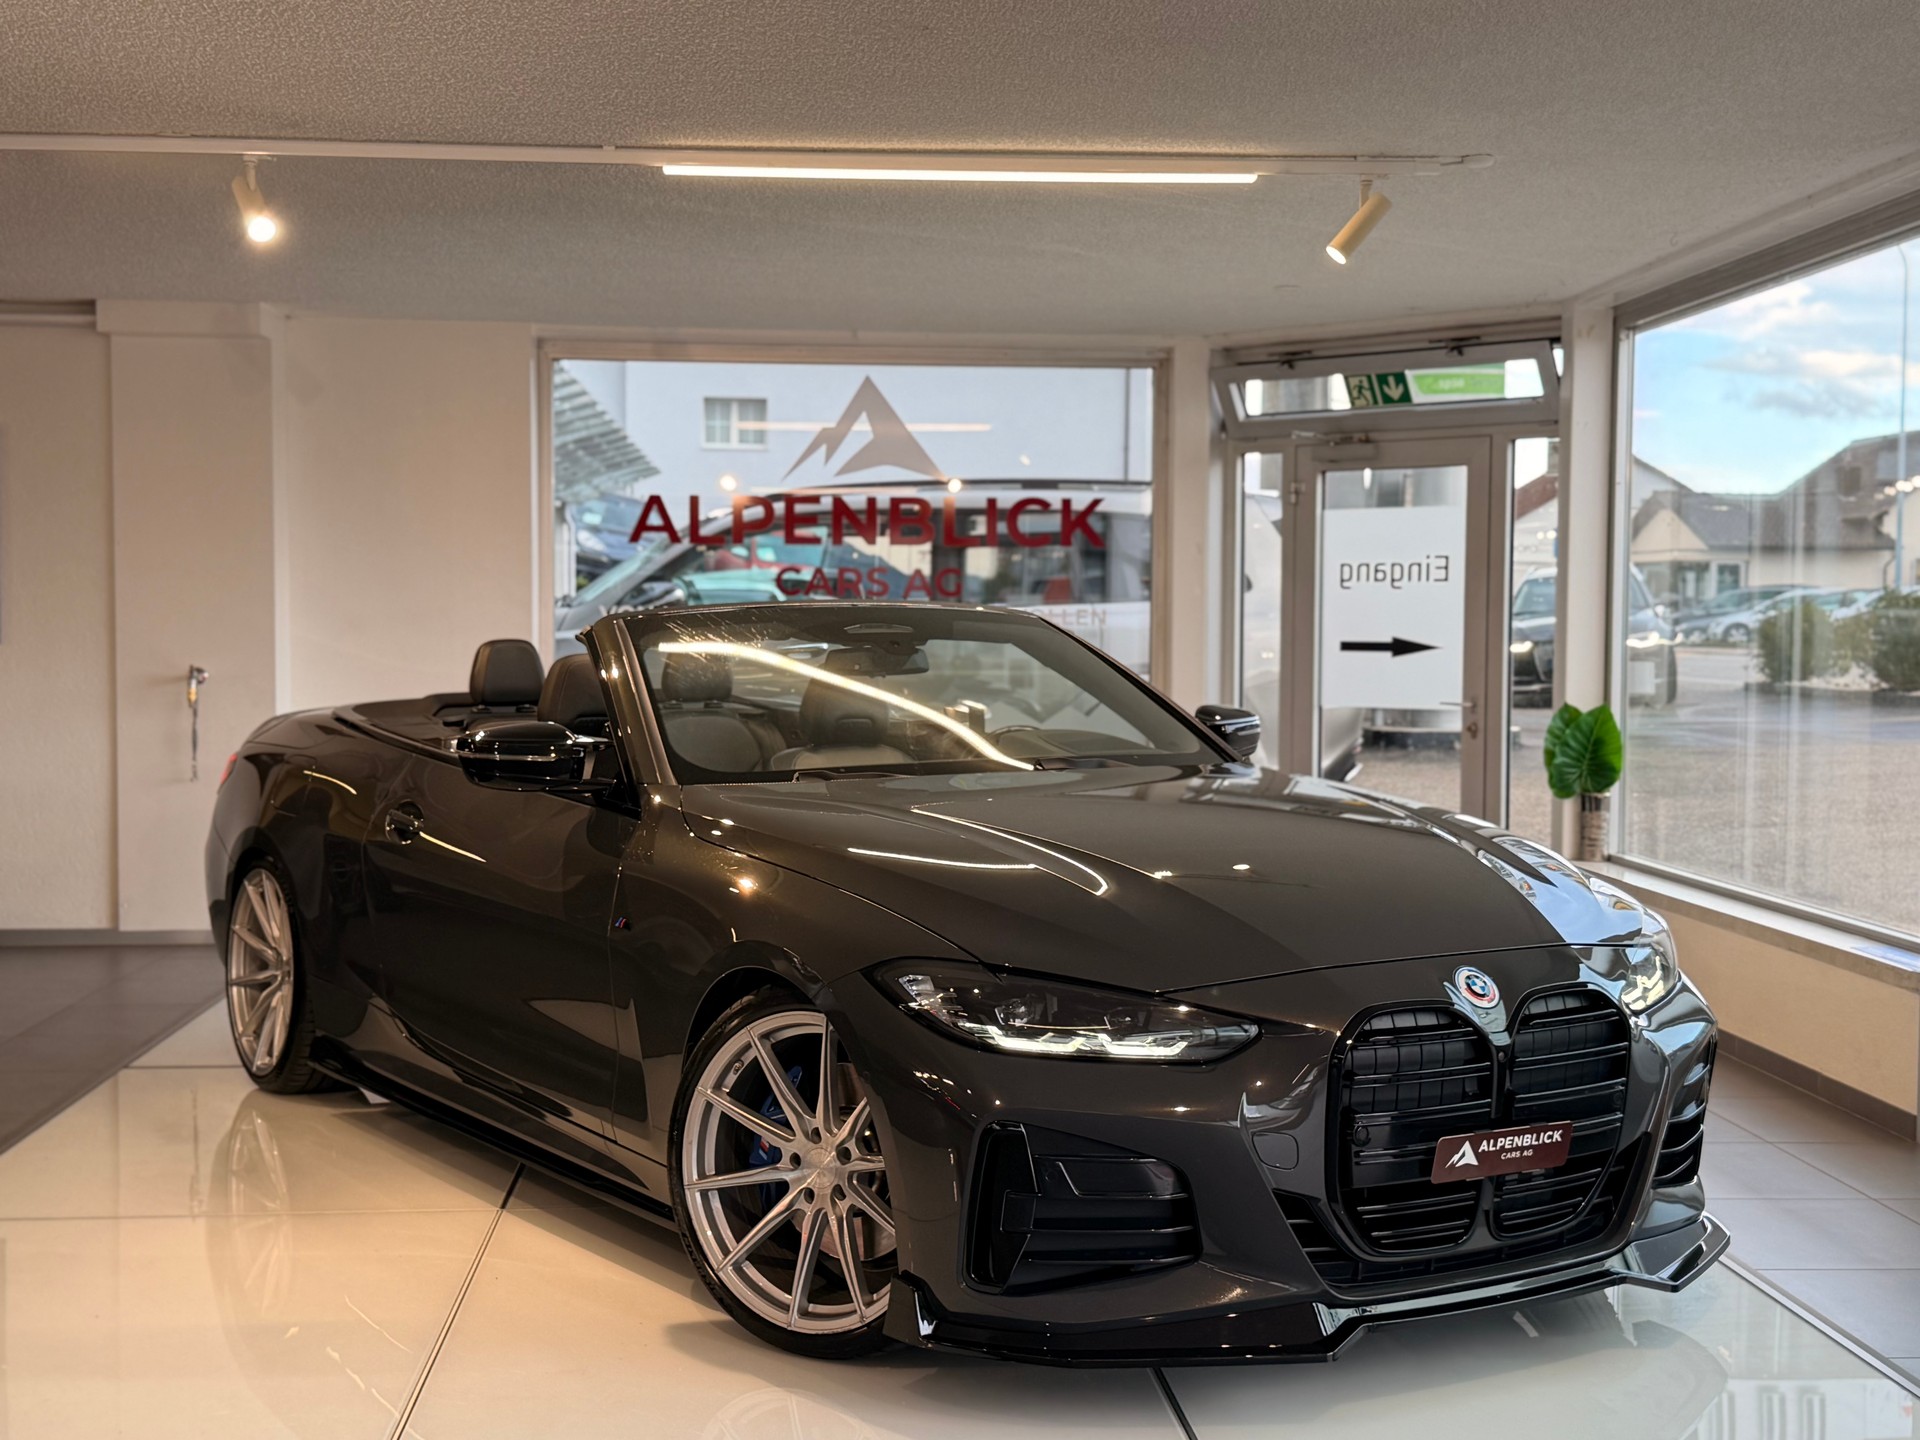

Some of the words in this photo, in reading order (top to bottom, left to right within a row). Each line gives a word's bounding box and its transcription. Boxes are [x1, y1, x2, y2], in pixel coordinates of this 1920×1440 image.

[629, 495, 1105, 548] ALPENBLICK
[776, 566, 890, 598] CARS
[902, 568, 962, 598] AG
[1478, 1130, 1563, 1153] ALPENBLICK
[1501, 1151, 1520, 1160] CARS
[1522, 1149, 1533, 1157] AG
